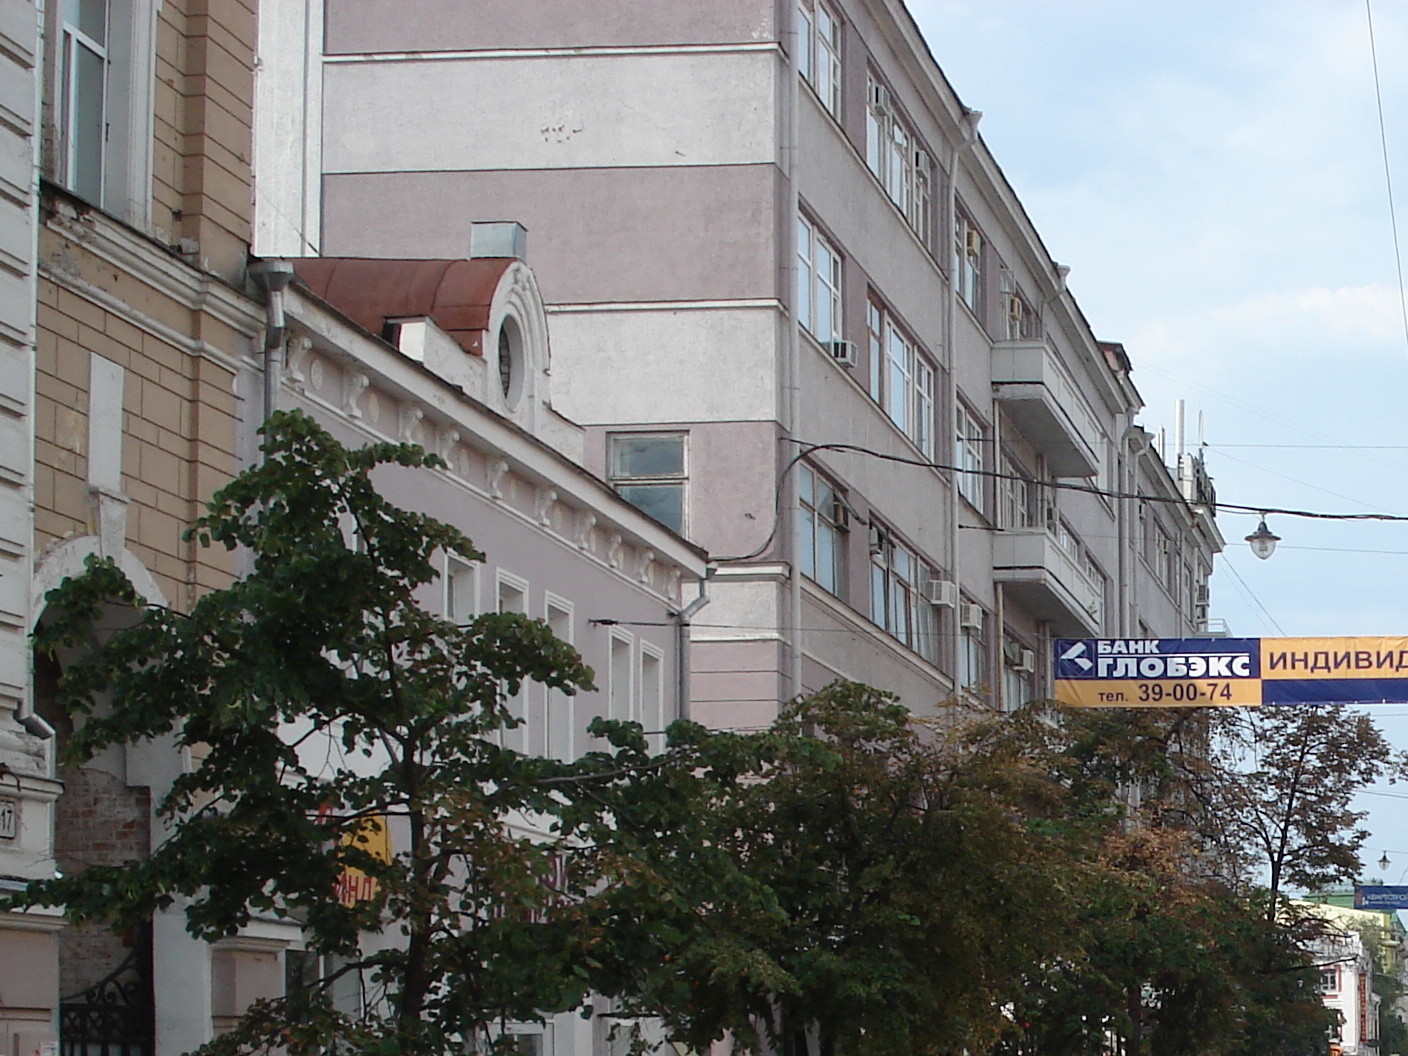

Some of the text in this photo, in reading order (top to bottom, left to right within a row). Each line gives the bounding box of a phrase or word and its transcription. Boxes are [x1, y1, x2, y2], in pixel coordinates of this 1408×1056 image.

[1097, 640, 1160, 654] БАНК
[1097, 656, 1250, 678] ГЛОБЭКС
[1098, 682, 1233, 702] тел. 39-00-74
